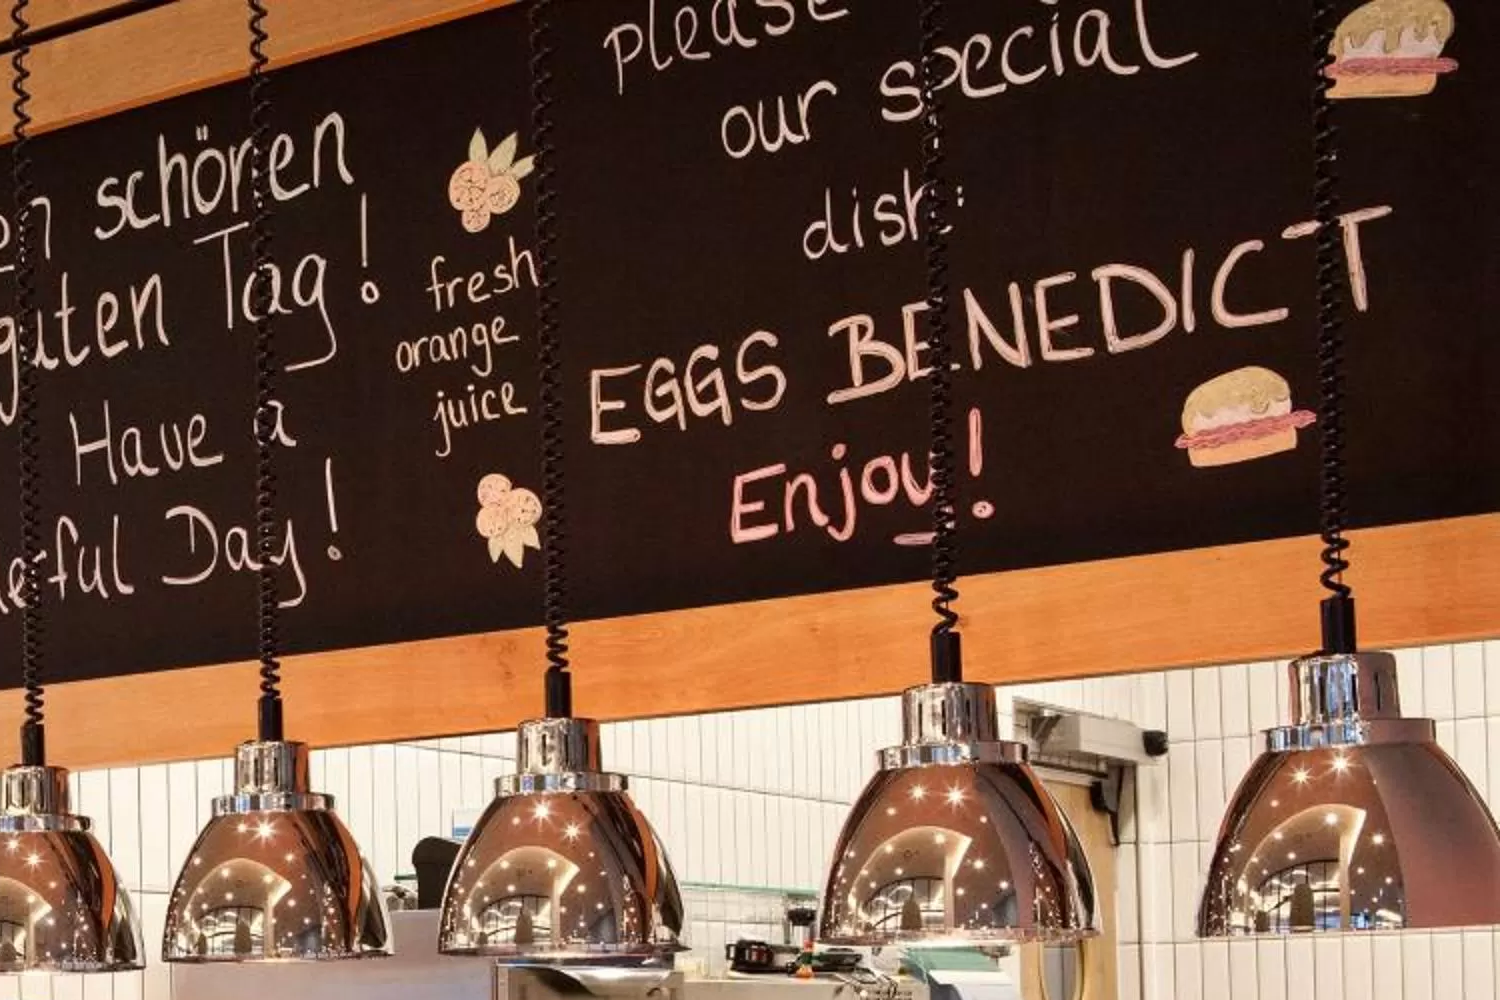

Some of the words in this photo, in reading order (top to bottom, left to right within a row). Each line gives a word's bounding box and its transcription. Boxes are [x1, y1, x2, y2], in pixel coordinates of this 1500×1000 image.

[721, 79, 837, 159] our
[880, 0, 1200, 150] special
[426, 235, 540, 312] fresh
[396, 315, 520, 377] orange
[590, 330, 788, 444] EGGS
[826, 205, 1393, 404] BENEDICT
[68, 401, 224, 486] Have
[253, 400, 297, 447] a
[433, 380, 528, 457] juice
[730, 406, 996, 546] Enjoy!
